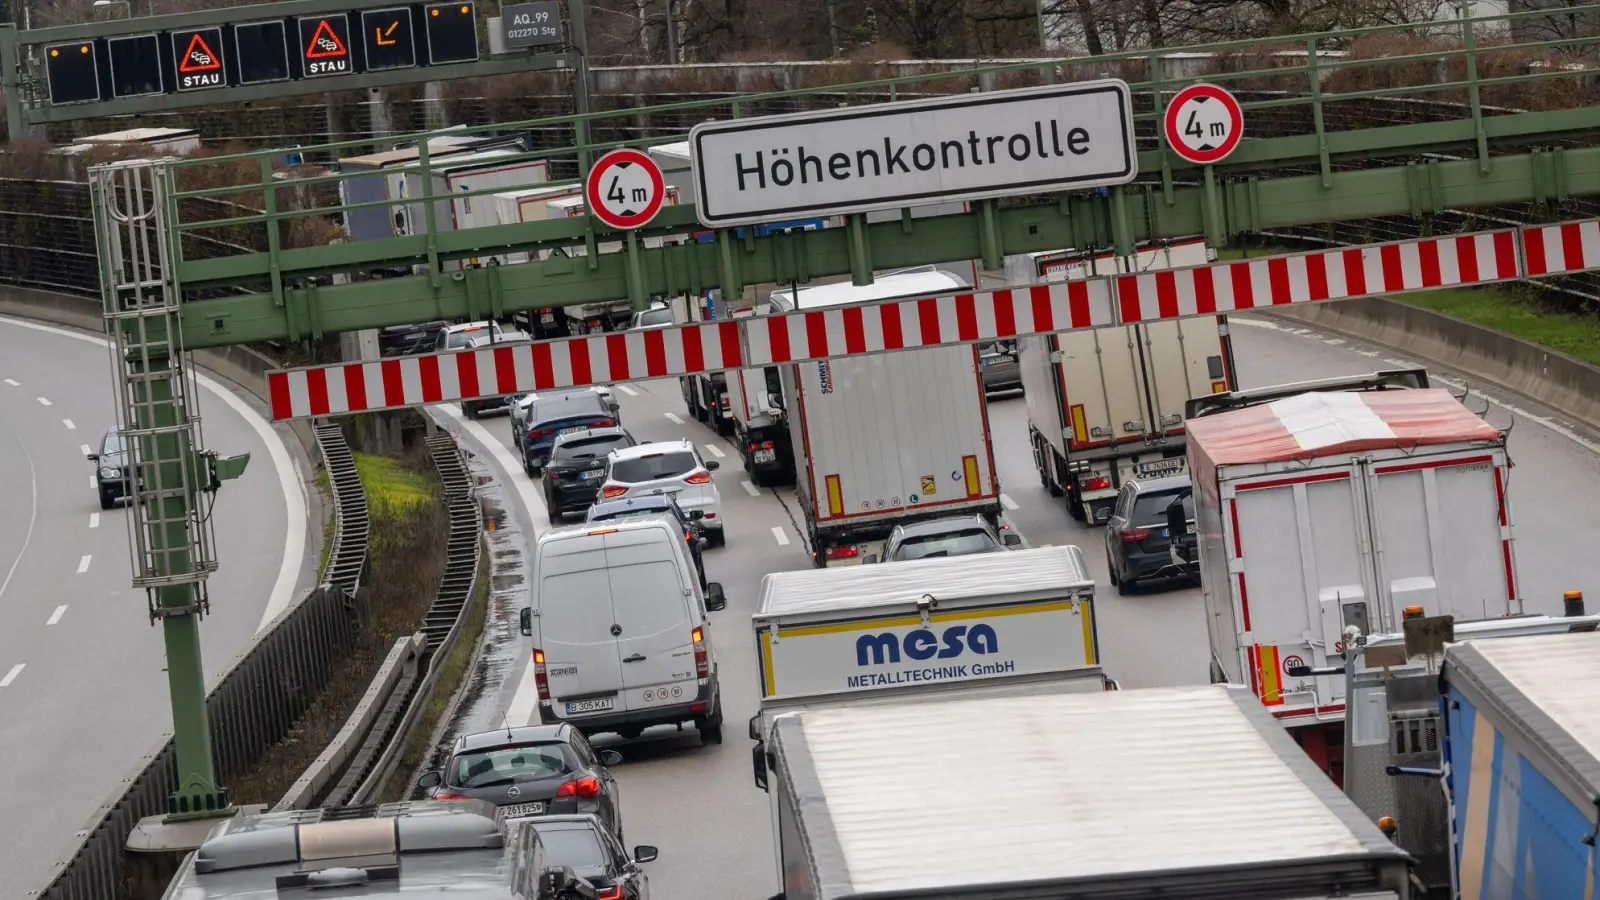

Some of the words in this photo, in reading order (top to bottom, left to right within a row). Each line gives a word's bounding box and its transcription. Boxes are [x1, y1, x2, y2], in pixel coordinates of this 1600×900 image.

[508, 28, 538, 39] 012270
[541, 26, 556, 37] Stg
[309, 60, 346, 73] STAU
[183, 73, 219, 87] STAU
[1184, 109, 1205, 139] 4
[1210, 121, 1226, 138] m
[734, 119, 1091, 192] Höhenkontrolle
[606, 175, 626, 205] 4
[631, 187, 647, 203] m
[856, 622, 999, 667] mesa
[847, 664, 969, 689] METALLTECHNIK
[971, 659, 1015, 677] GmbH
[571, 702, 577, 712] B
[579, 701, 594, 711] 305
[595, 699, 610, 709] KAT
[507, 803, 537, 816] 261825
